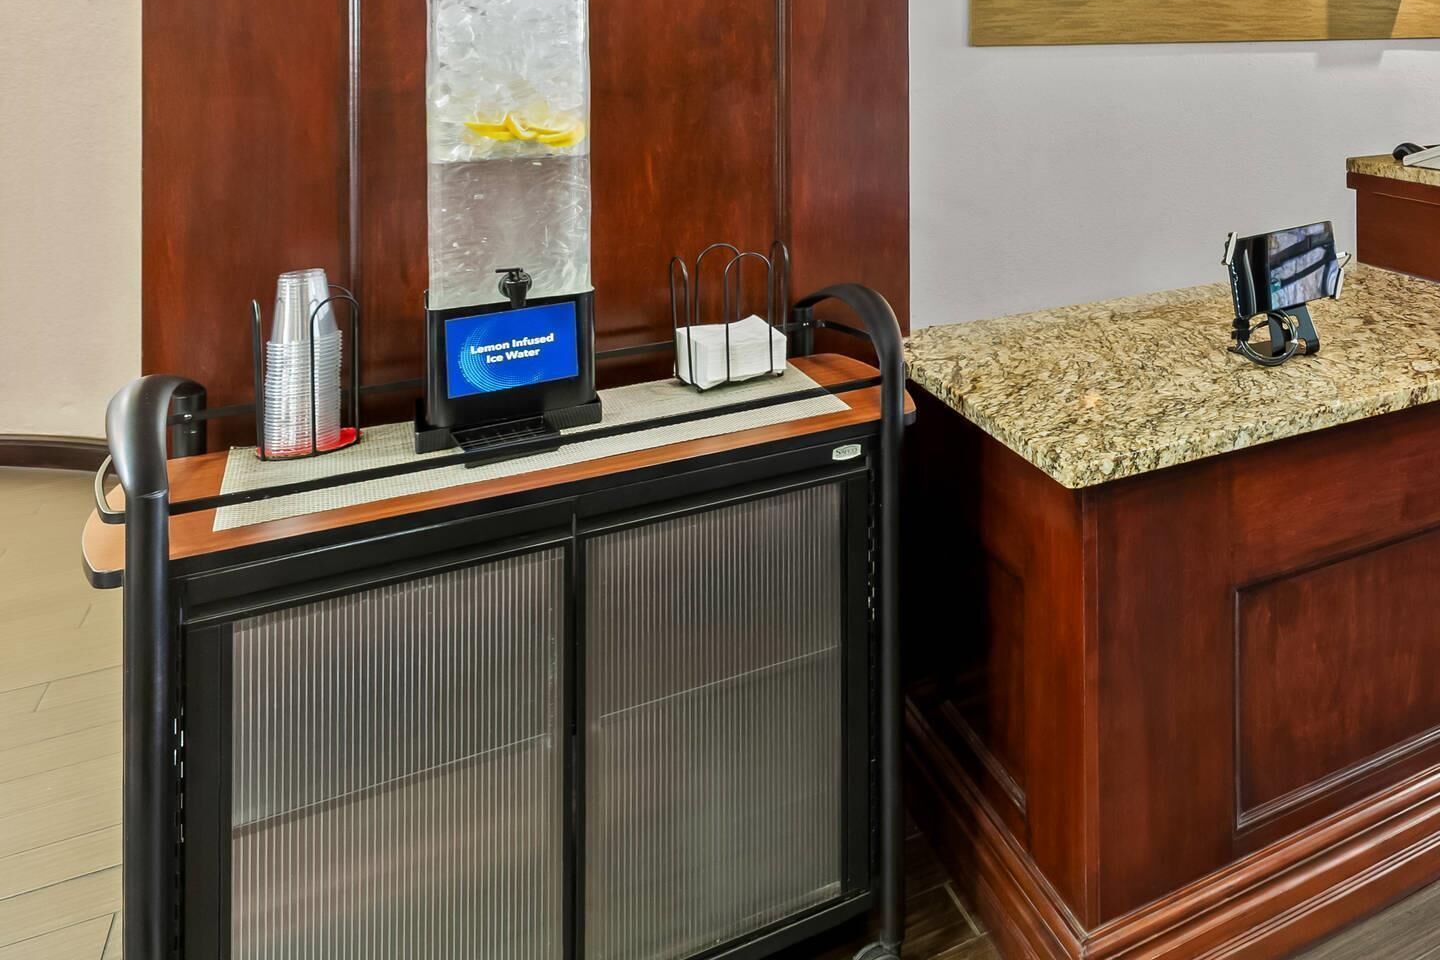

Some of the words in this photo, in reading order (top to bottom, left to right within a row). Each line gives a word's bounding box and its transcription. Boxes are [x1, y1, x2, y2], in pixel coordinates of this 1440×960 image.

[470, 342, 510, 355] Lemon
[511, 333, 554, 347] Infused
[486, 354, 504, 363] Ice
[505, 348, 540, 360] Water
